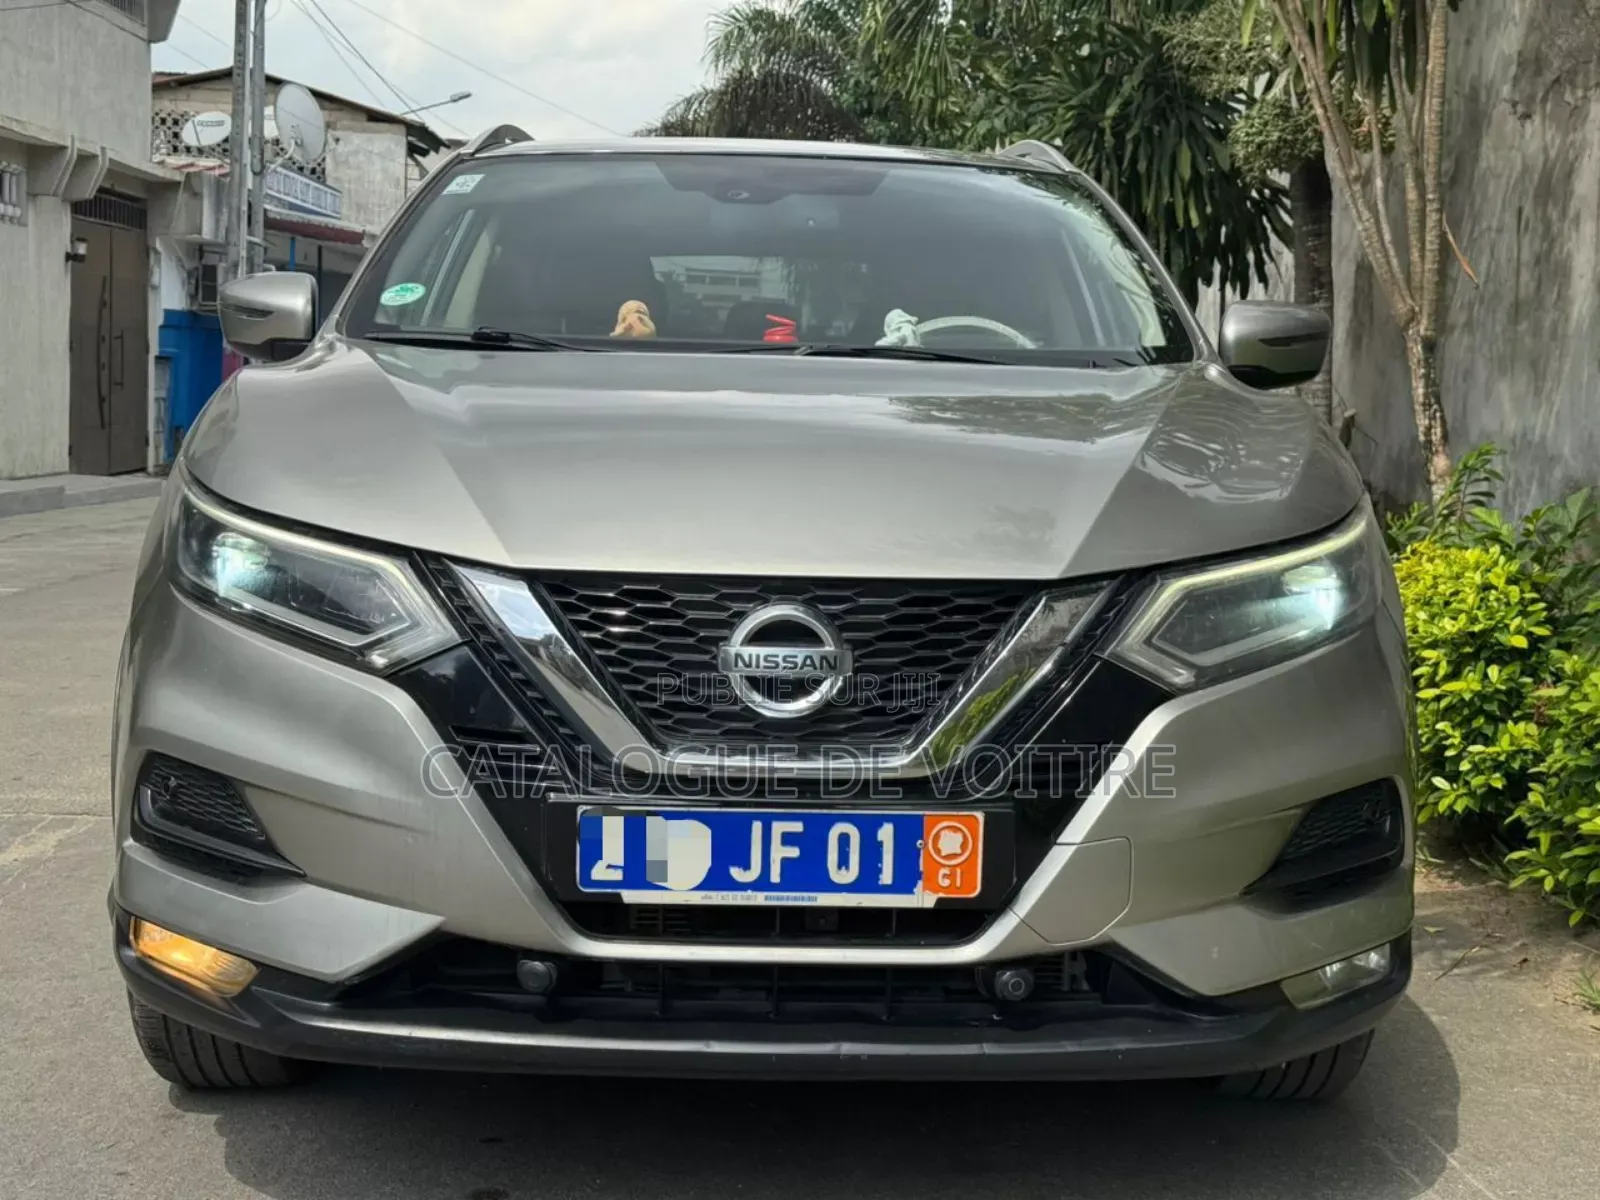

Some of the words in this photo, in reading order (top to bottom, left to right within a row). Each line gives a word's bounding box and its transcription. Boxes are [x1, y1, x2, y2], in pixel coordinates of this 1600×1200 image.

[734, 653, 838, 671] NISSAN
[728, 820, 804, 884] JF
[827, 821, 895, 885] 01
